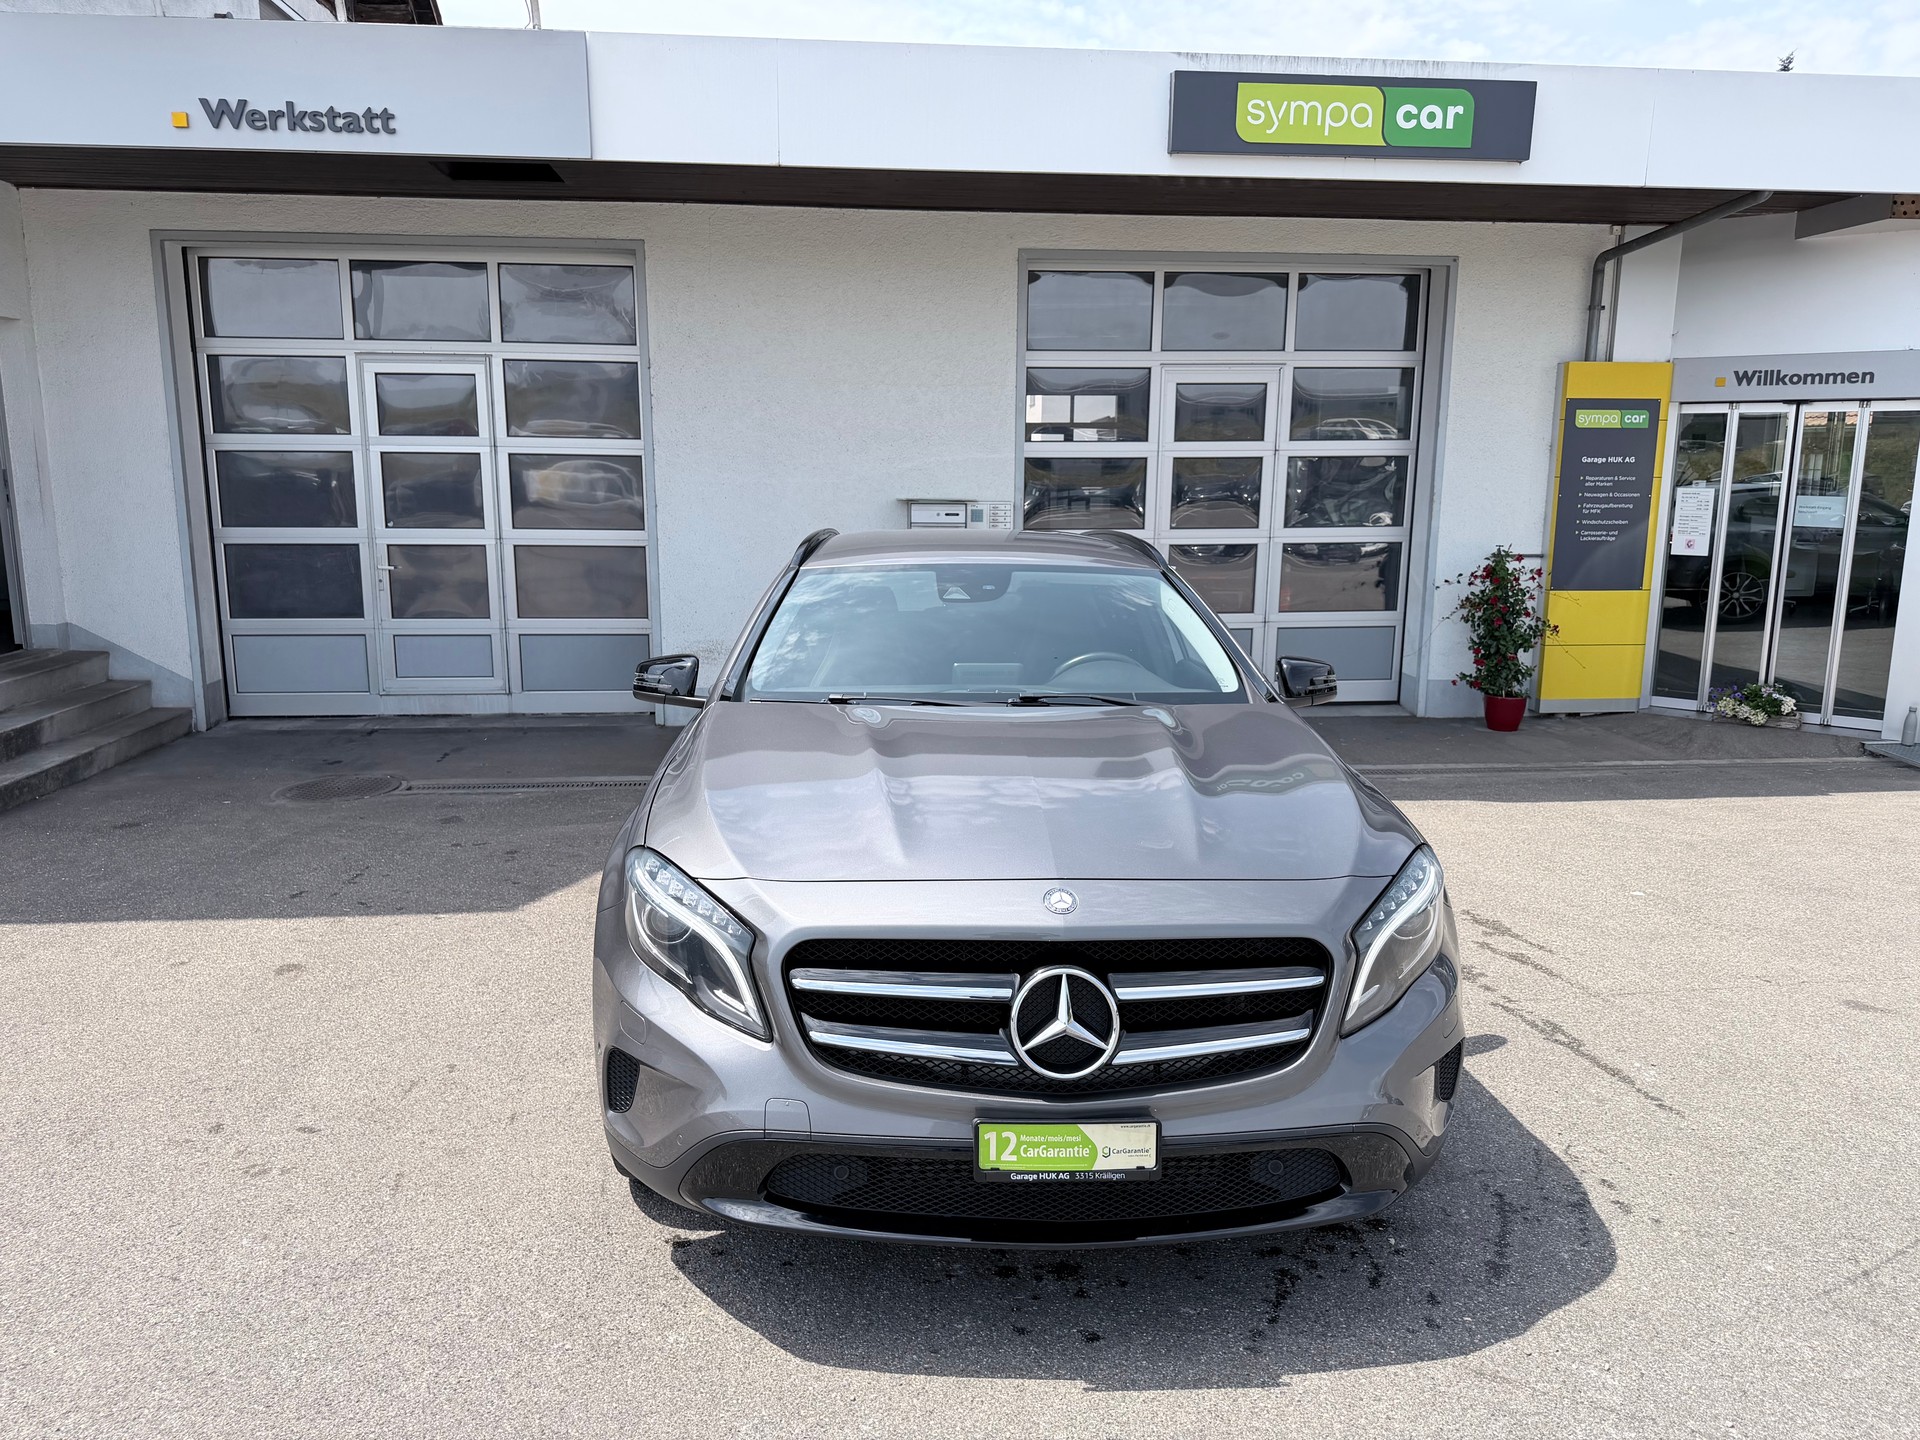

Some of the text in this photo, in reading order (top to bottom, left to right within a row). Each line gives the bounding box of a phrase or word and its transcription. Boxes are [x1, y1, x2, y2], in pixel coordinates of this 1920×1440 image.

[198, 97, 397, 135] Werkstatt
[1246, 98, 1465, 136] sympa car
[1733, 369, 1875, 387] Willkommen
[1578, 414, 1646, 426] sympa car
[1581, 456, 1607, 464] Garage
[983, 1131, 1018, 1162] 12
[1020, 1144, 1090, 1158] CarGarantie
[1111, 1147, 1150, 1155] CarGarantie
[1010, 1172, 1038, 1181] Garage
[1039, 1172, 1058, 1180] HUK
[1058, 1172, 1070, 1180] AG
[1075, 1172, 1094, 1180] 3315
